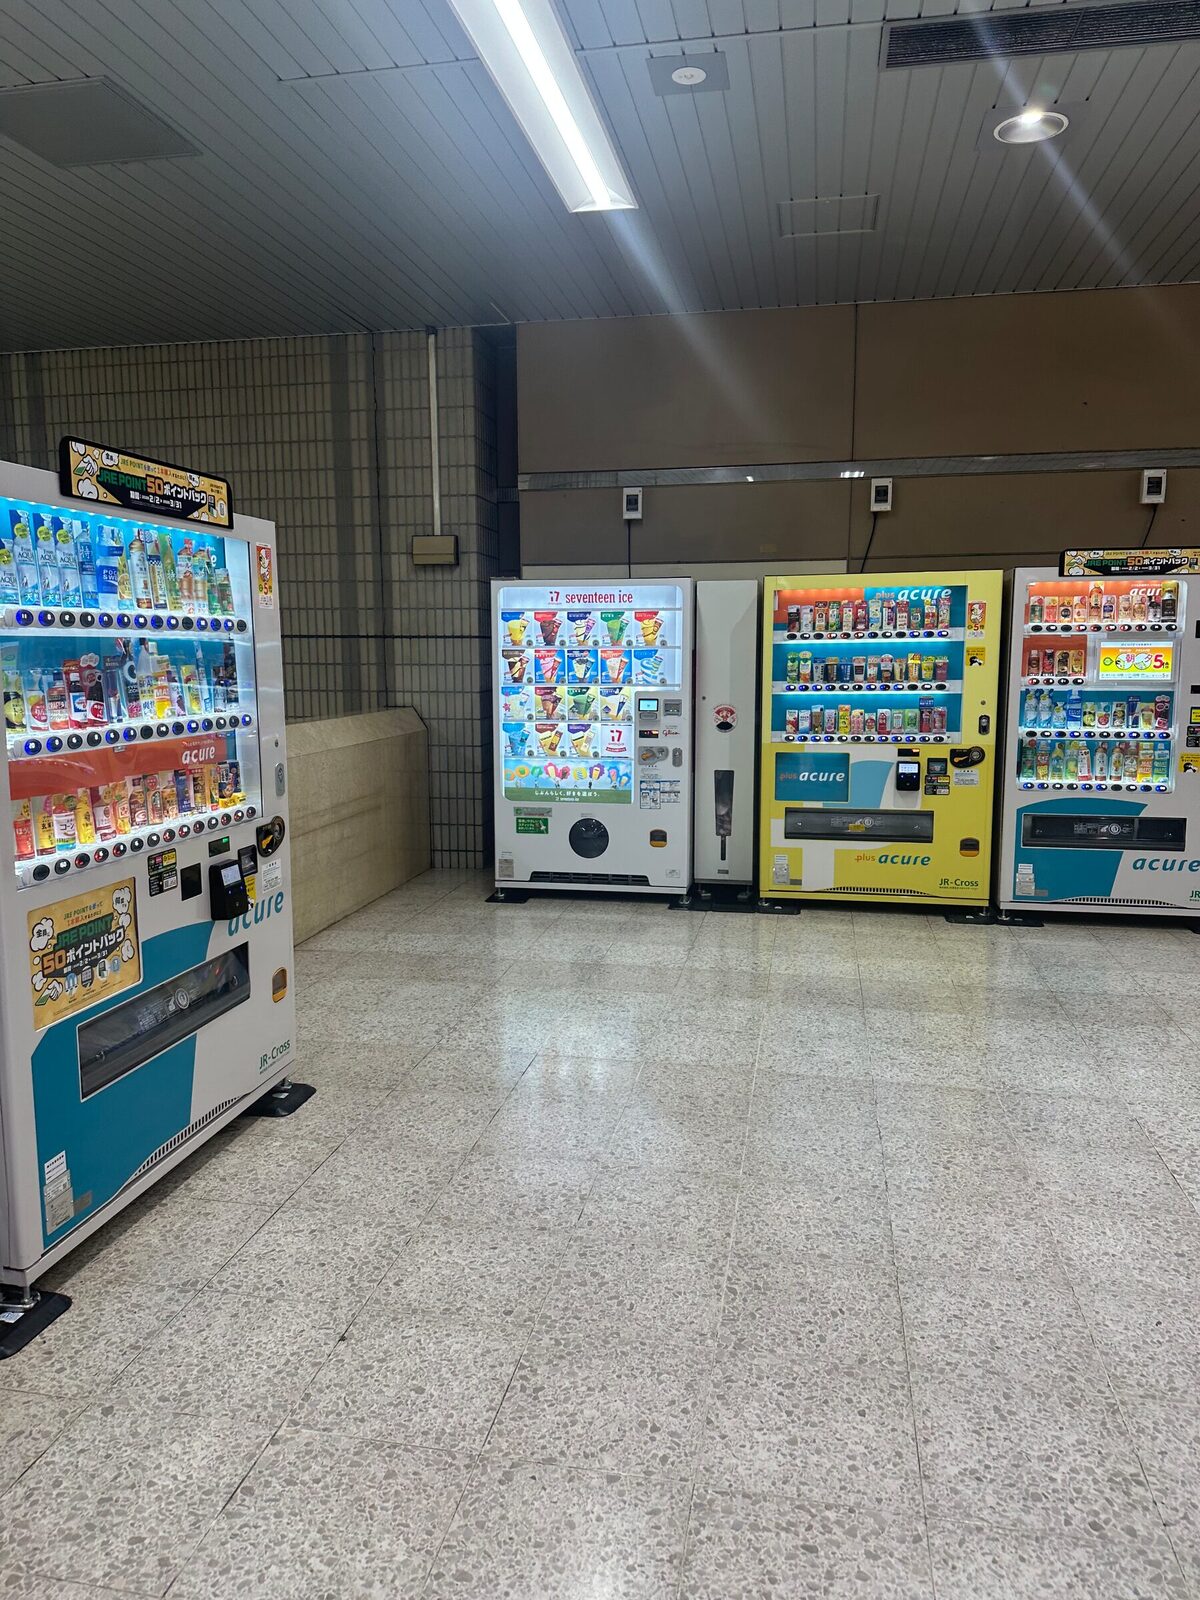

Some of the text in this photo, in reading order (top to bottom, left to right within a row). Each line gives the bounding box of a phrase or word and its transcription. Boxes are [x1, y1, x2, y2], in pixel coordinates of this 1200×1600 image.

[98, 469, 118, 485] JRE
[118, 474, 147, 491] POINT
[566, 591, 615, 604] seventeen
[618, 590, 633, 604] ice
[898, 588, 951, 601] acure
[1130, 587, 1162, 596] acur
[182, 746, 215, 764] acure
[799, 771, 845, 782] acure
[856, 852, 931, 866] plus acure
[1132, 857, 1200, 872] acure
[939, 878, 979, 888] JR-Cross
[228, 891, 284, 936] acure
[55, 916, 114, 950] JRE POINT
[259, 1039, 291, 1070] JR-Cross
